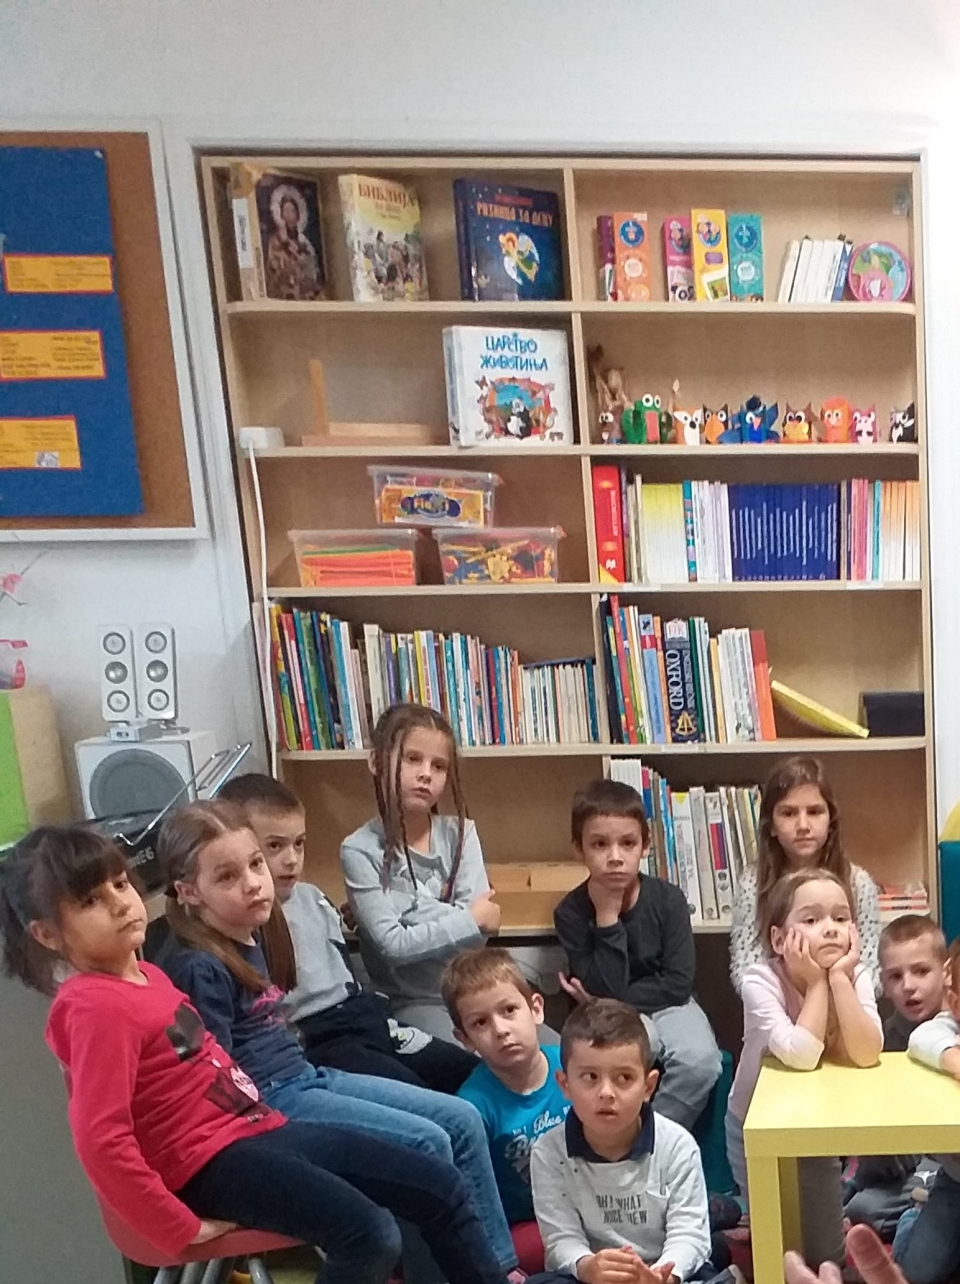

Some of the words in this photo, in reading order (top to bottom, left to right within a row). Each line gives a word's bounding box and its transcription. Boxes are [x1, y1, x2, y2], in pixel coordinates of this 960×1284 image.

[485, 333, 538, 354] ЦАРСТВО
[480, 354, 548, 371] ЖИВОТИЊА
[665, 650, 685, 711] OXFORD
